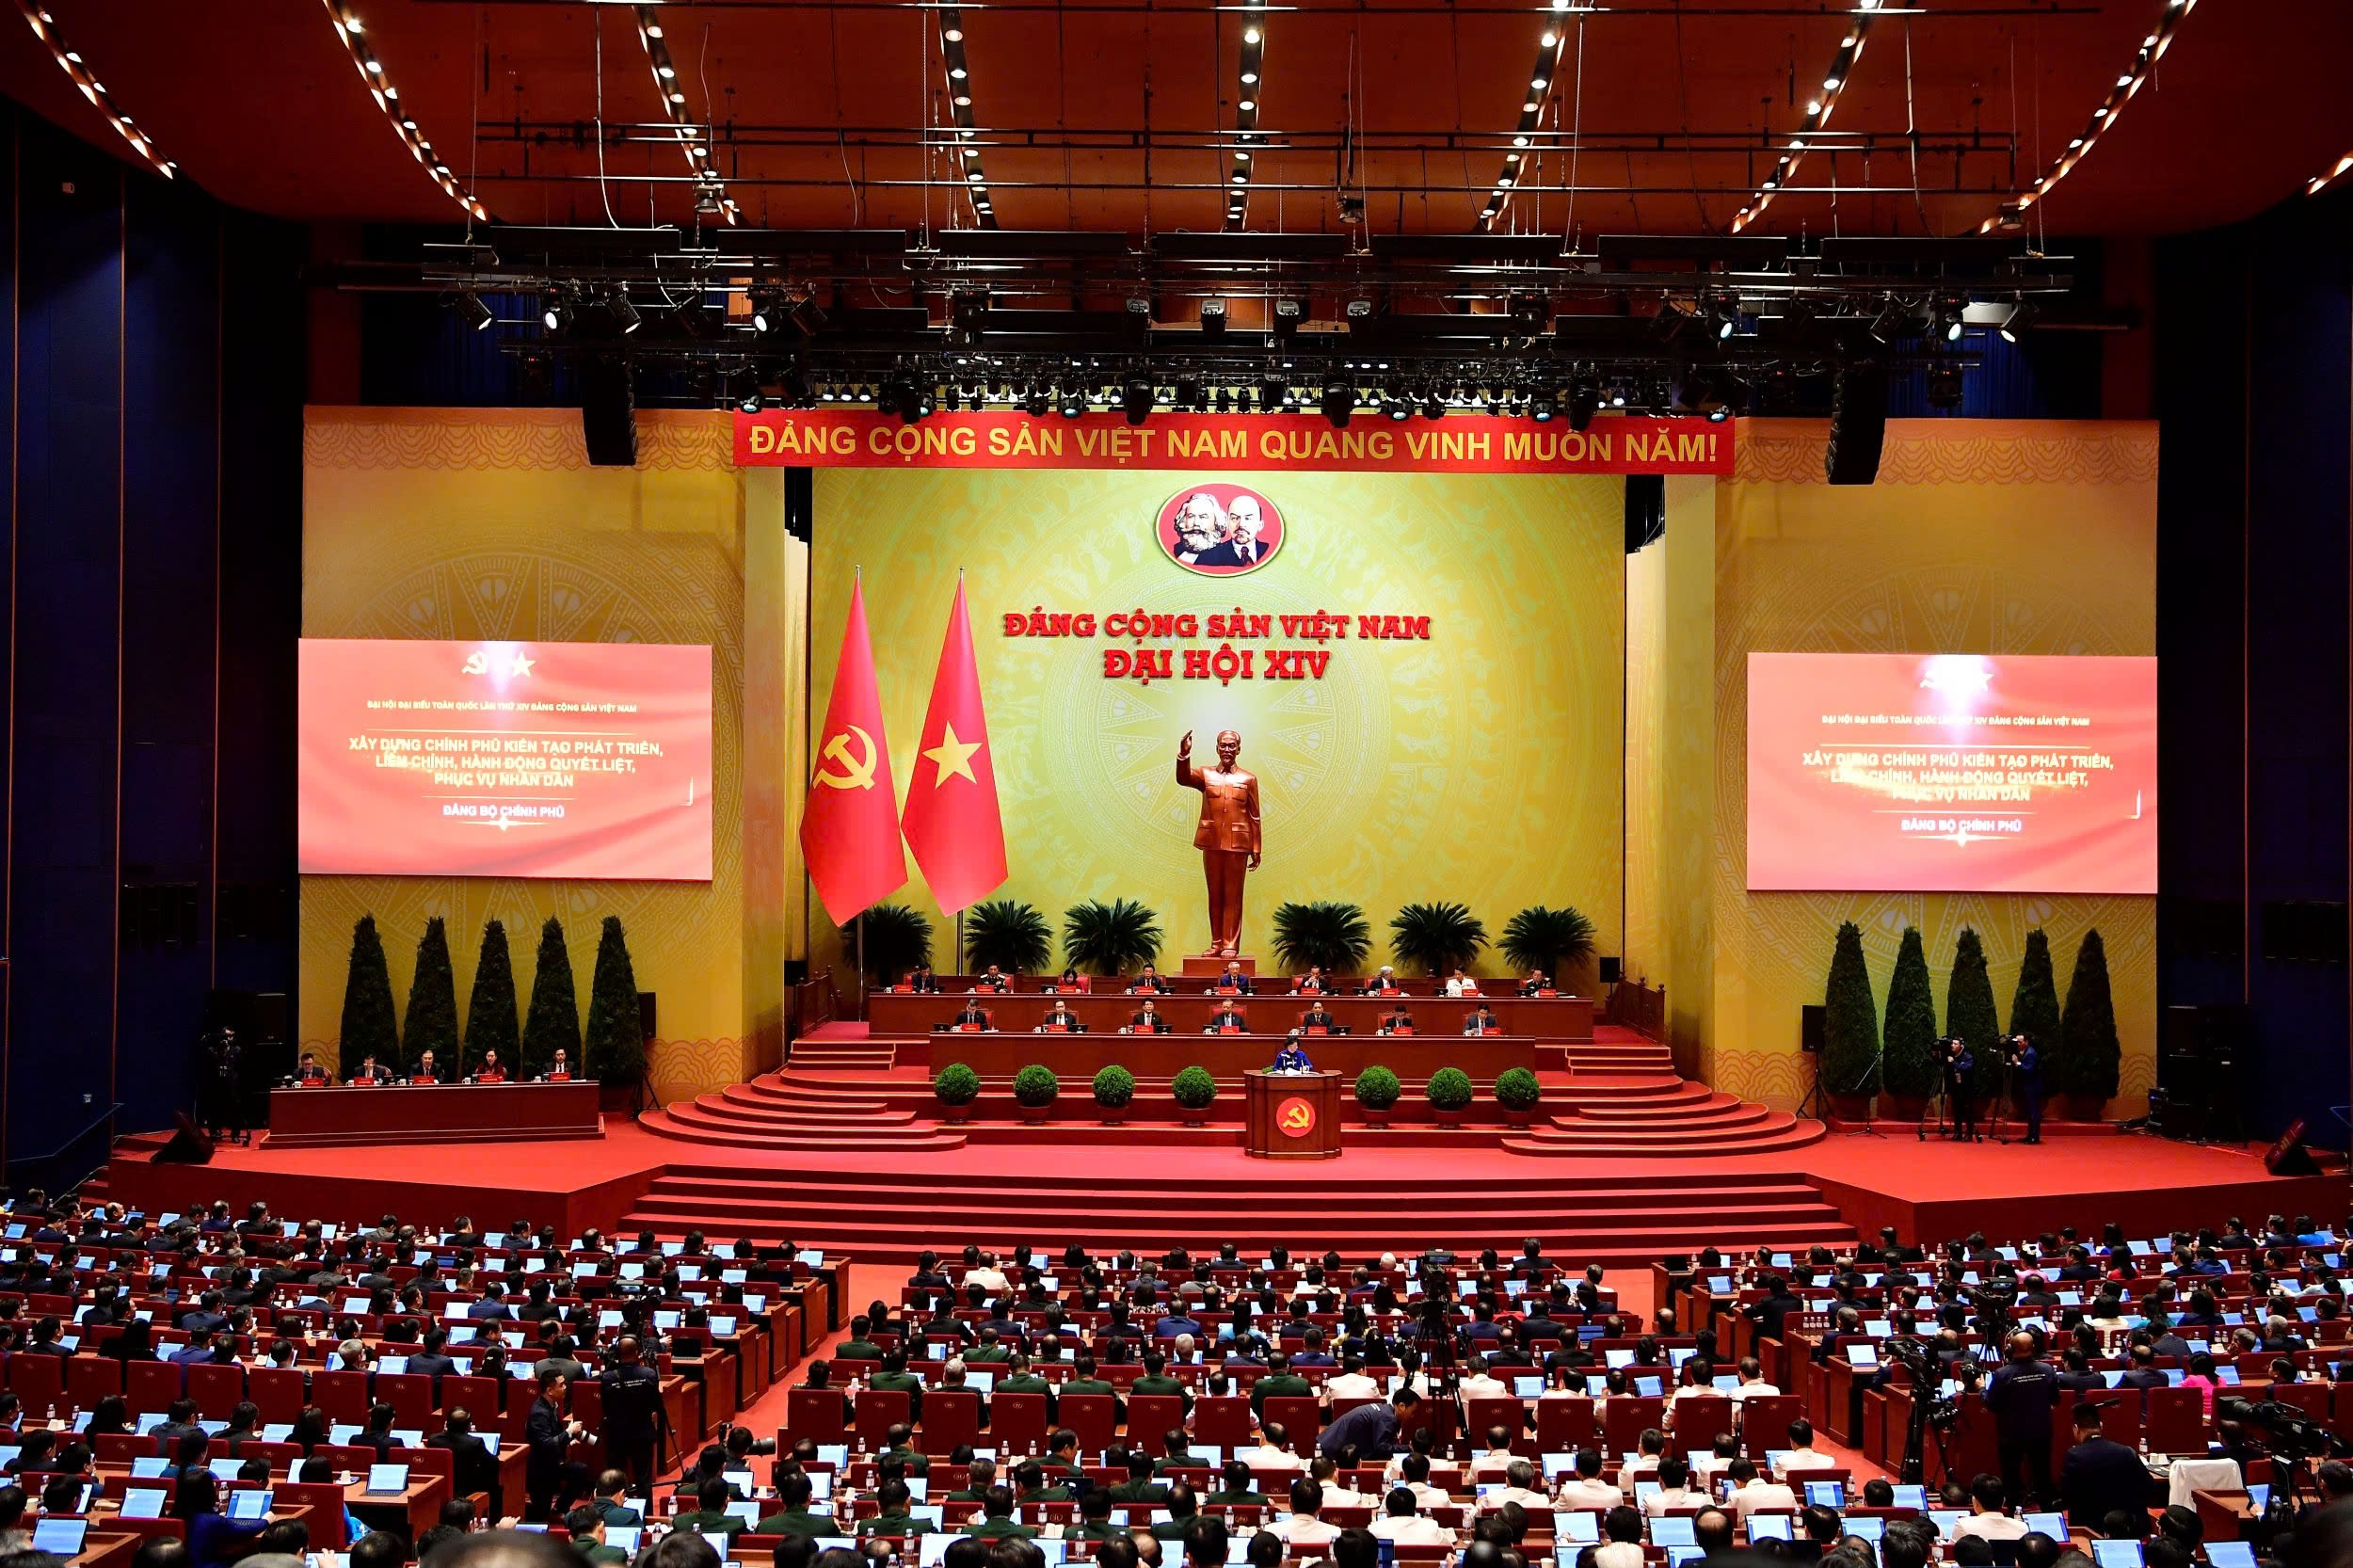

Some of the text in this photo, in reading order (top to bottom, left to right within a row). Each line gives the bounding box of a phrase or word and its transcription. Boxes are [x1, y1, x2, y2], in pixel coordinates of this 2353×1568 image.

[749, 419, 856, 455] ĐẢNG
[869, 424, 977, 462] CỘNG
[988, 421, 1064, 456] SẢN
[1075, 426, 1155, 463] VIỆT
[1167, 429, 1247, 457] NAM
[1259, 430, 1394, 460] QUANG
[1405, 431, 1490, 460] VINH
[1625, 426, 1717, 462] NĂM!
[1003, 605, 1431, 644] ĐẢNG CỘNG SẢN VIỆT NAM
[1104, 643, 1332, 685] ĐẠI HỘI XIV
[555, 701, 579, 712] CỘNG
[617, 704, 637, 713] NAM
[349, 734, 377, 750] XÂY
[424, 737, 468, 751] CHÍNH
[472, 737, 501, 752] PHỦ
[541, 741, 571, 756] TẠO
[574, 739, 614, 754] PHÁT
[411, 753, 457, 770] CHÍNH,
[461, 754, 502, 769] HÀNH
[504, 755, 547, 771] ĐỘNG
[602, 757, 635, 774] LIỆT,
[1802, 749, 1833, 766] XÂY
[1882, 751, 1927, 766] CHÍNH
[1930, 751, 1959, 767] PHỦ
[1998, 754, 2027, 770] TẠO
[2030, 753, 2068, 768] PHÁT
[434, 772, 473, 788] PHỤC
[476, 773, 496, 788] VỤ
[1920, 768, 1960, 784] HÀNH
[442, 802, 565, 818] ĐẢNG BỘ CHÍNH PHỦ
[1939, 819, 1956, 833] BỘ
